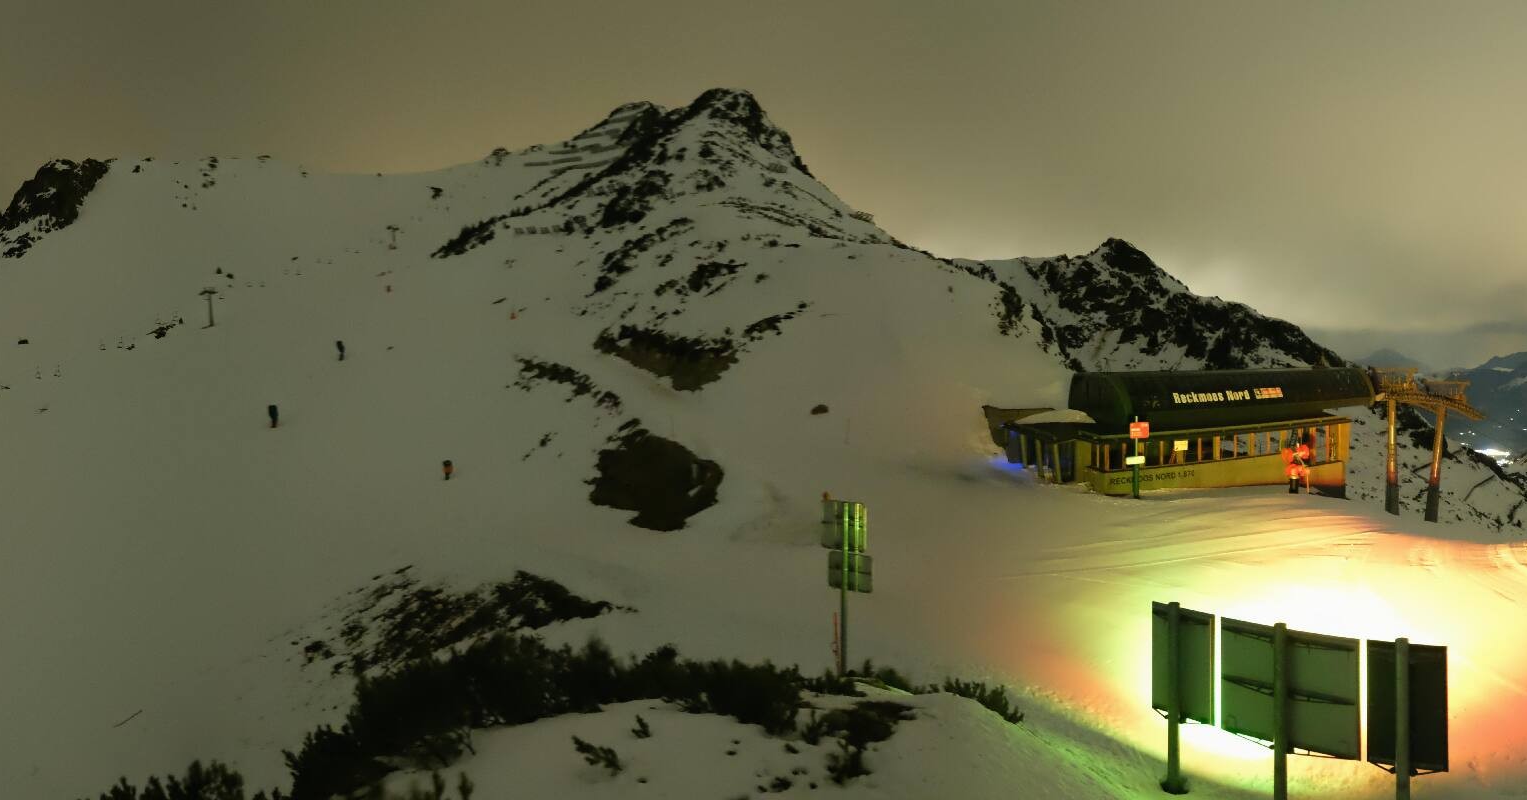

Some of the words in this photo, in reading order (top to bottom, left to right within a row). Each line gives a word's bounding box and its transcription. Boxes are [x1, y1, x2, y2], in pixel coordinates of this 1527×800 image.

[1172, 391, 1225, 404] Reckmoos
[1225, 388, 1251, 401] Nord
[1109, 474, 1154, 486] RECKOOS
